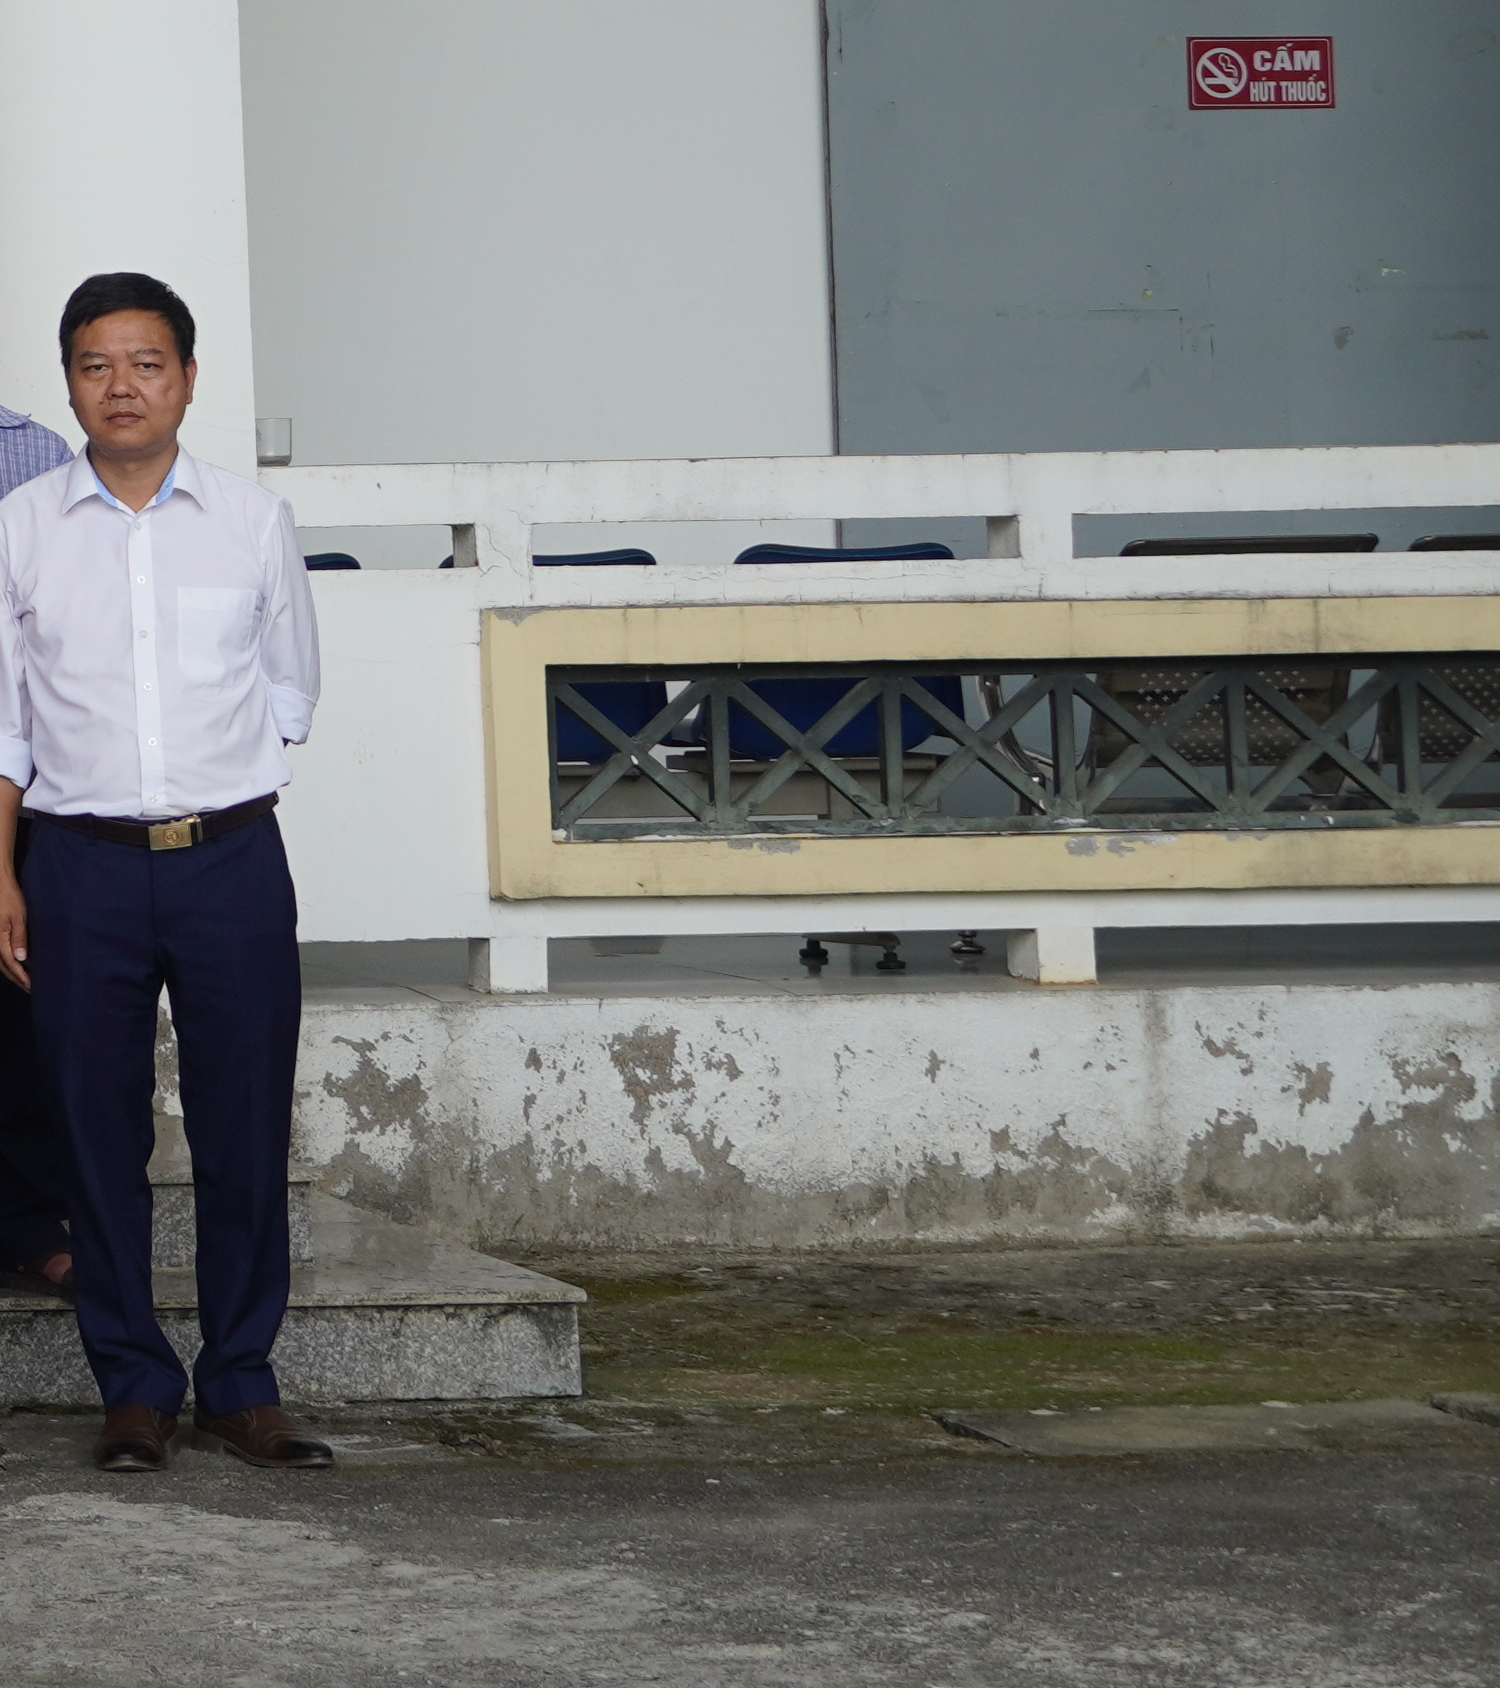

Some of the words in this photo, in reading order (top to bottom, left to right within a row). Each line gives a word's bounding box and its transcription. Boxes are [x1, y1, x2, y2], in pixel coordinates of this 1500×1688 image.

[1252, 42, 1321, 72] CẤM
[1250, 77, 1277, 103] HÚT
[1280, 74, 1326, 102] THUỐC
